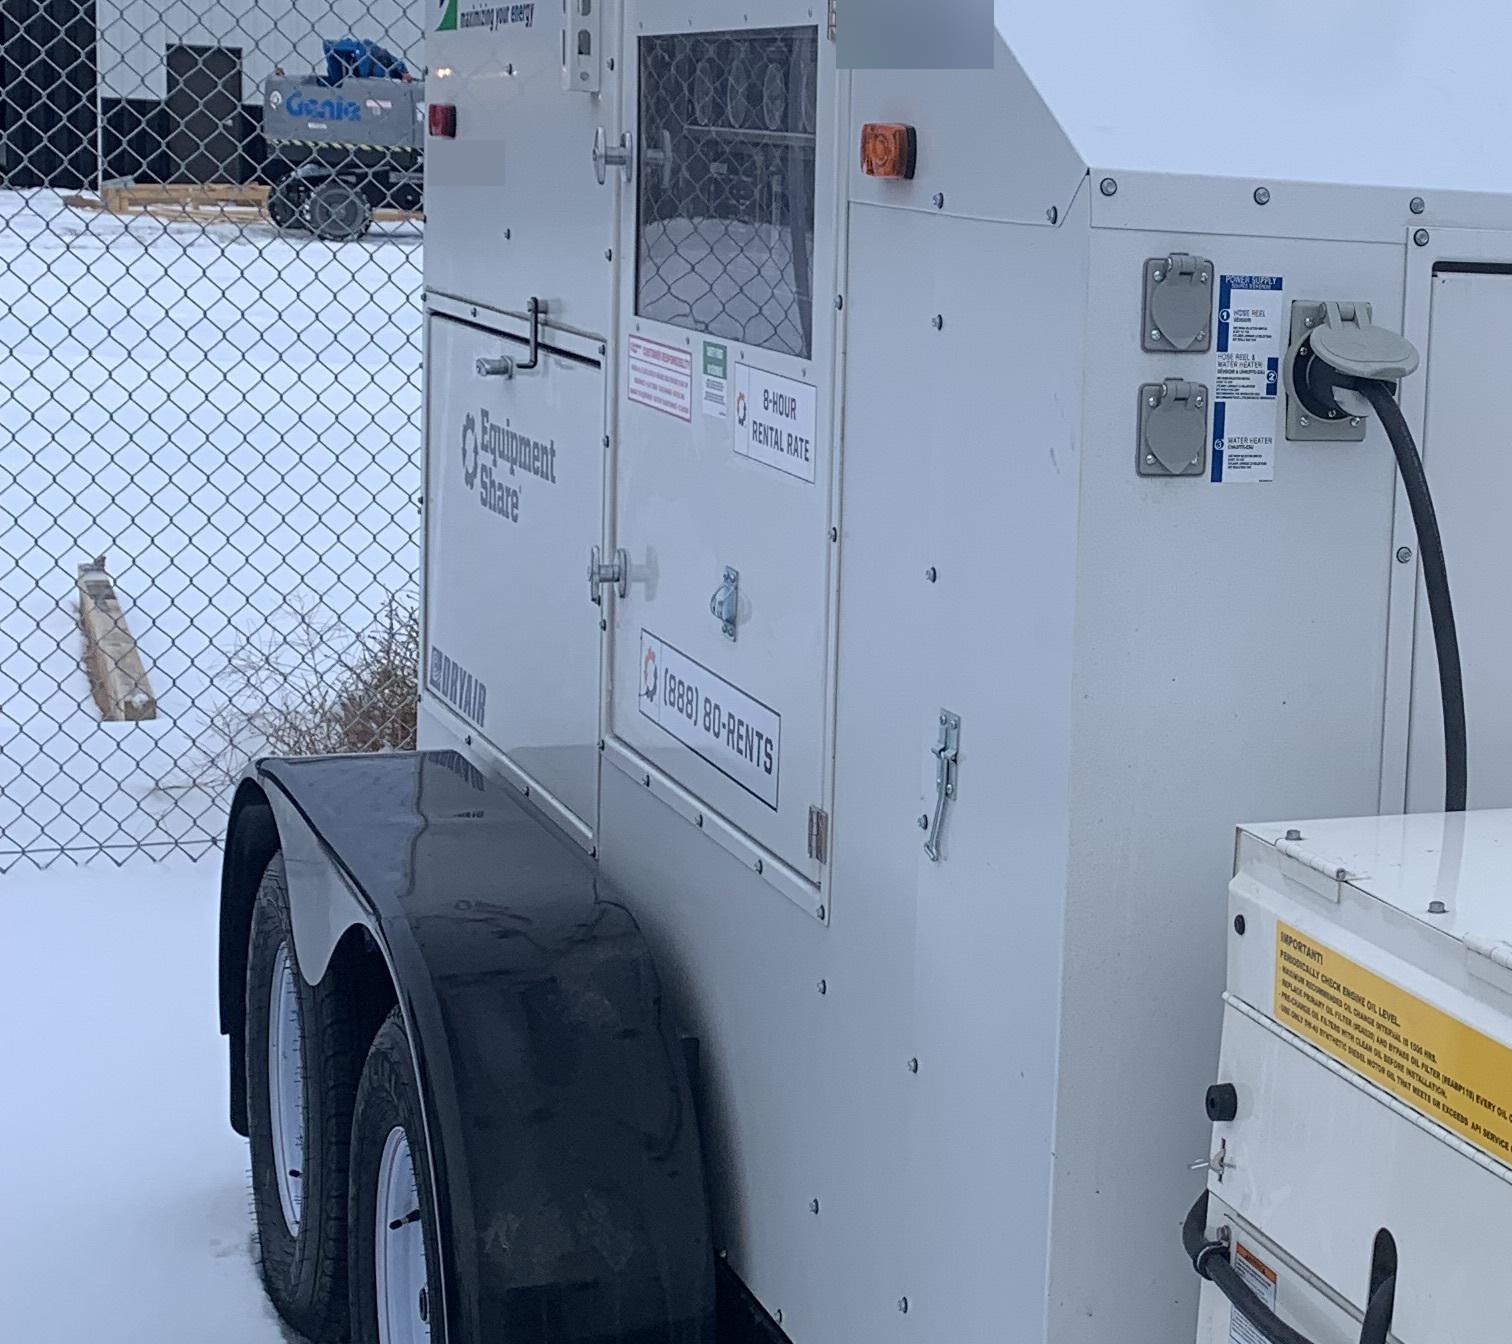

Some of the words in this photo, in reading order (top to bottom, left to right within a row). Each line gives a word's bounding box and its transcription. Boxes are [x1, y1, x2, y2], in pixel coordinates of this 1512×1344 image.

[286, 89, 362, 122] Genie
[1251, 276, 1277, 285] SUPPLY
[763, 388, 797, 421] 8-HOUR
[480, 407, 556, 484] Equipment
[752, 420, 784, 453] RENTAL
[787, 433, 810, 462] RATE
[480, 463, 519, 524] Share
[441, 654, 487, 729] DRYAIR
[663, 667, 699, 726] (888)
[703, 696, 774, 775] 80-RENTS
